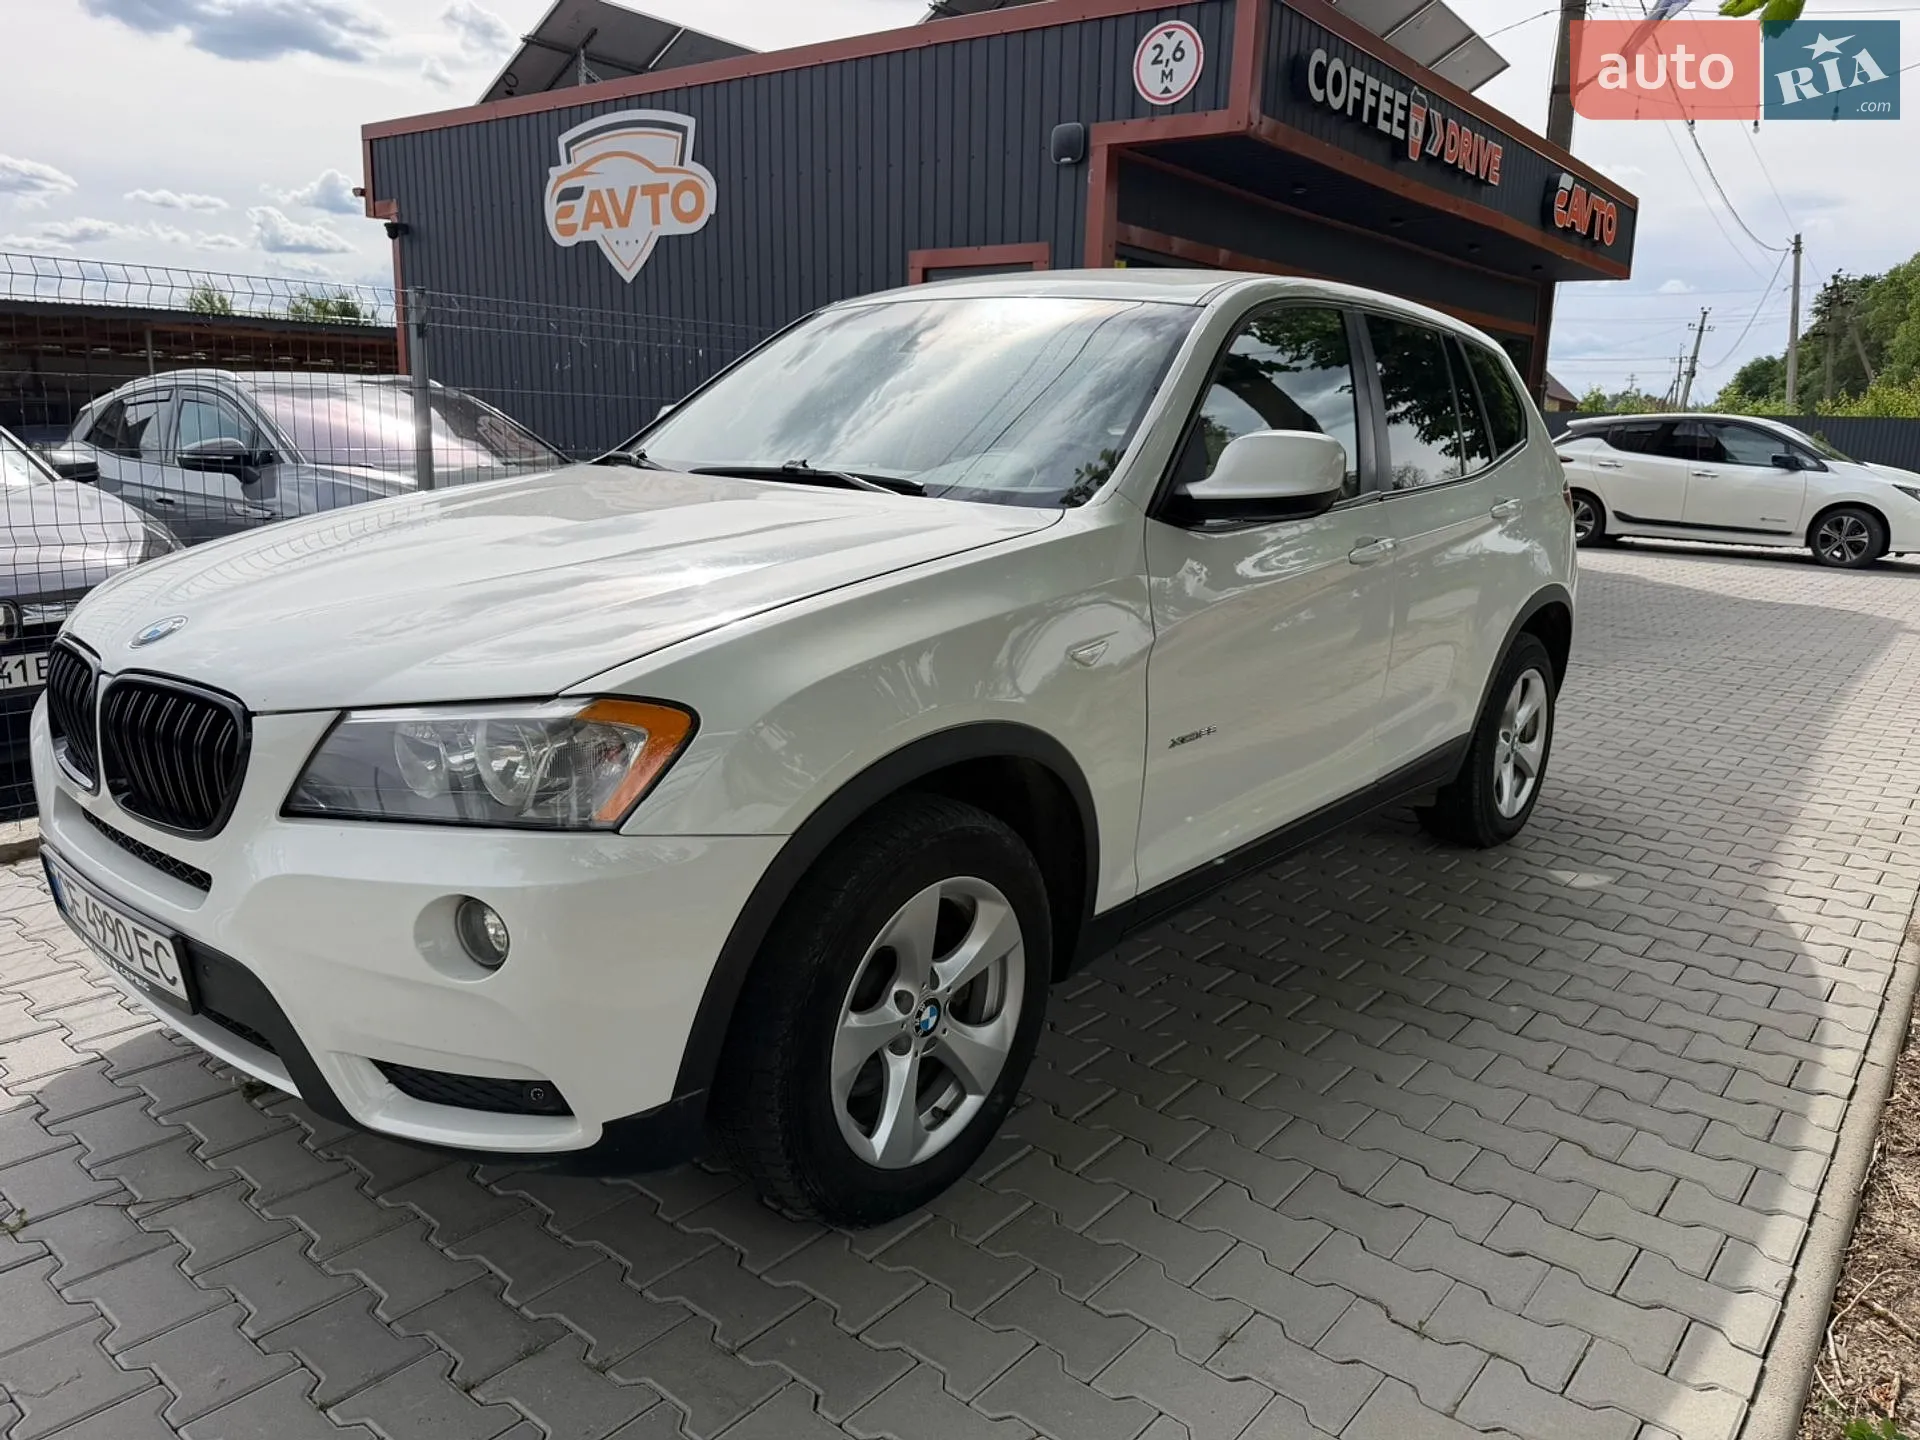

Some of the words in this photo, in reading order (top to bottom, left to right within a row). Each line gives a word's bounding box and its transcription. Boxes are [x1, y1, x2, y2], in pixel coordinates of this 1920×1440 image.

[1151, 40, 1186, 68] 2,6
[1308, 48, 1408, 141] COFFEE
[1443, 119, 1503, 187] DRIVE
[85, 895, 134, 963] 4990
[132, 927, 178, 987] EC
